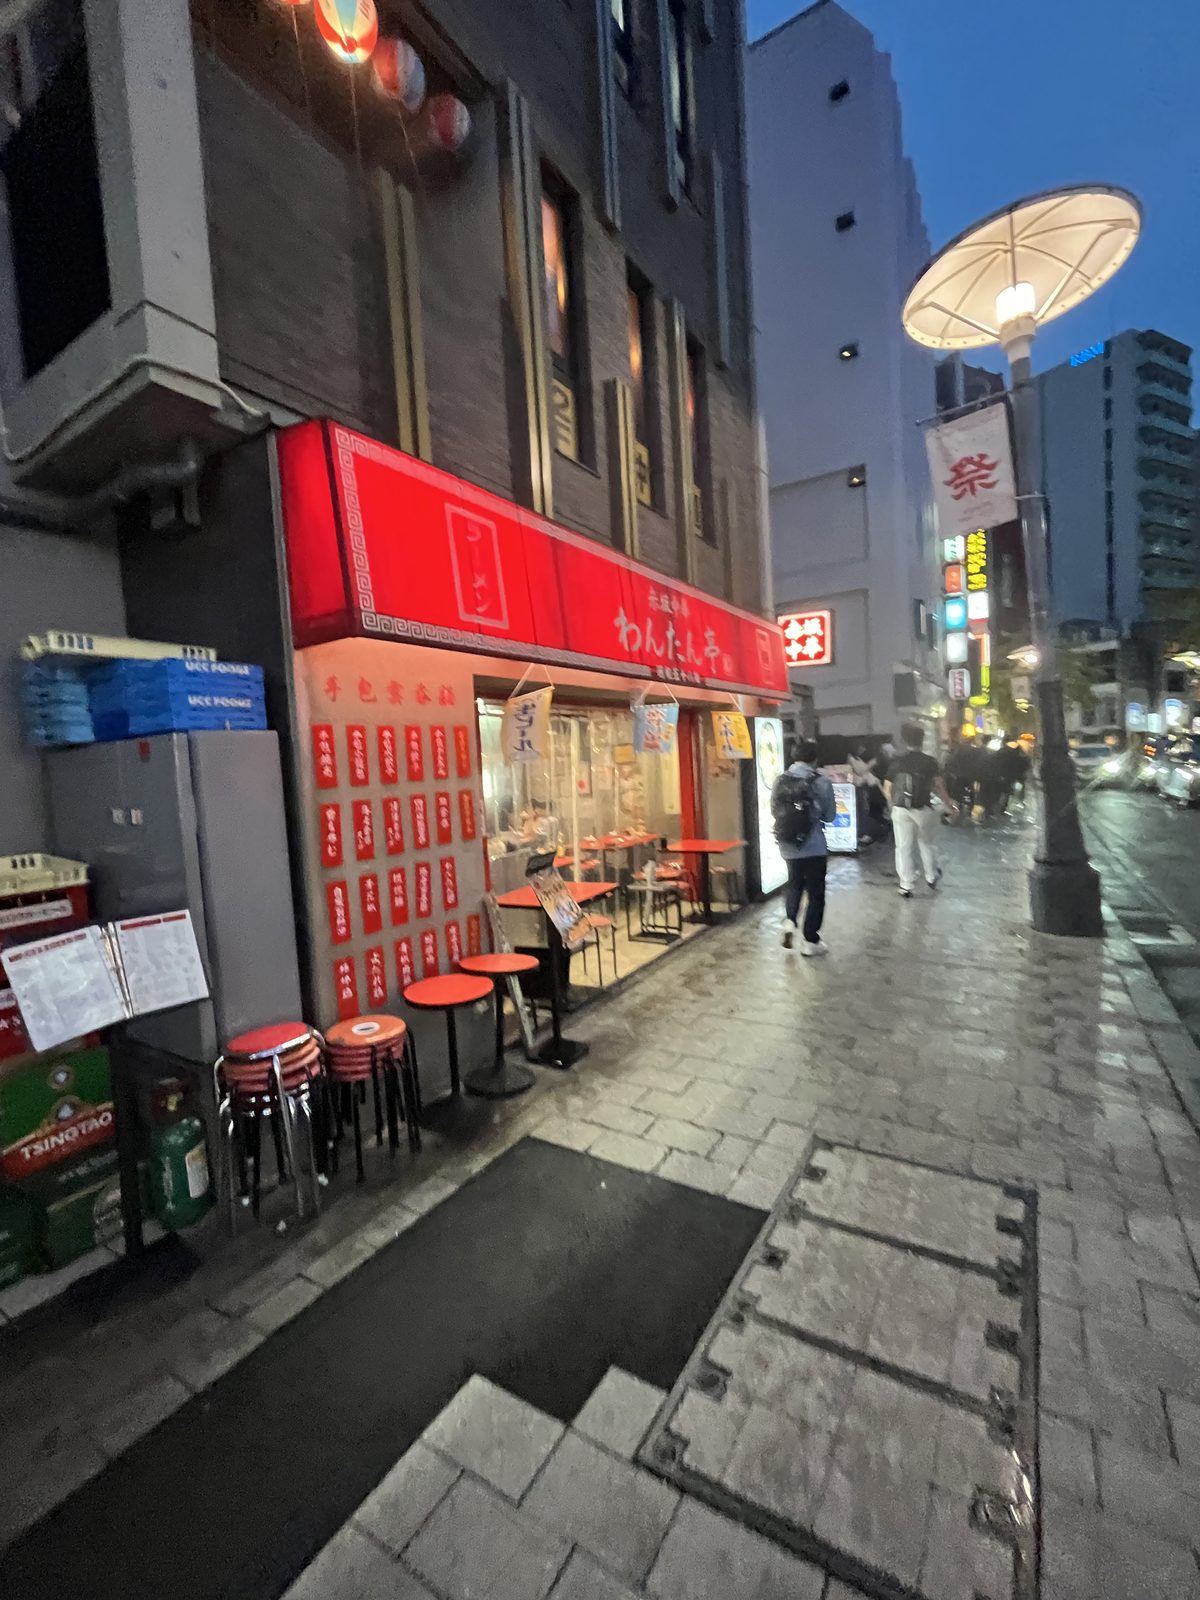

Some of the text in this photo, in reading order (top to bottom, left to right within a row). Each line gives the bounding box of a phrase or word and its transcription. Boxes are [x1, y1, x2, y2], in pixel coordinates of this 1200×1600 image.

[943, 453, 1001, 500] 祭
[465, 521, 492, 613] ラーメン
[614, 606, 720, 675] わんたん亭
